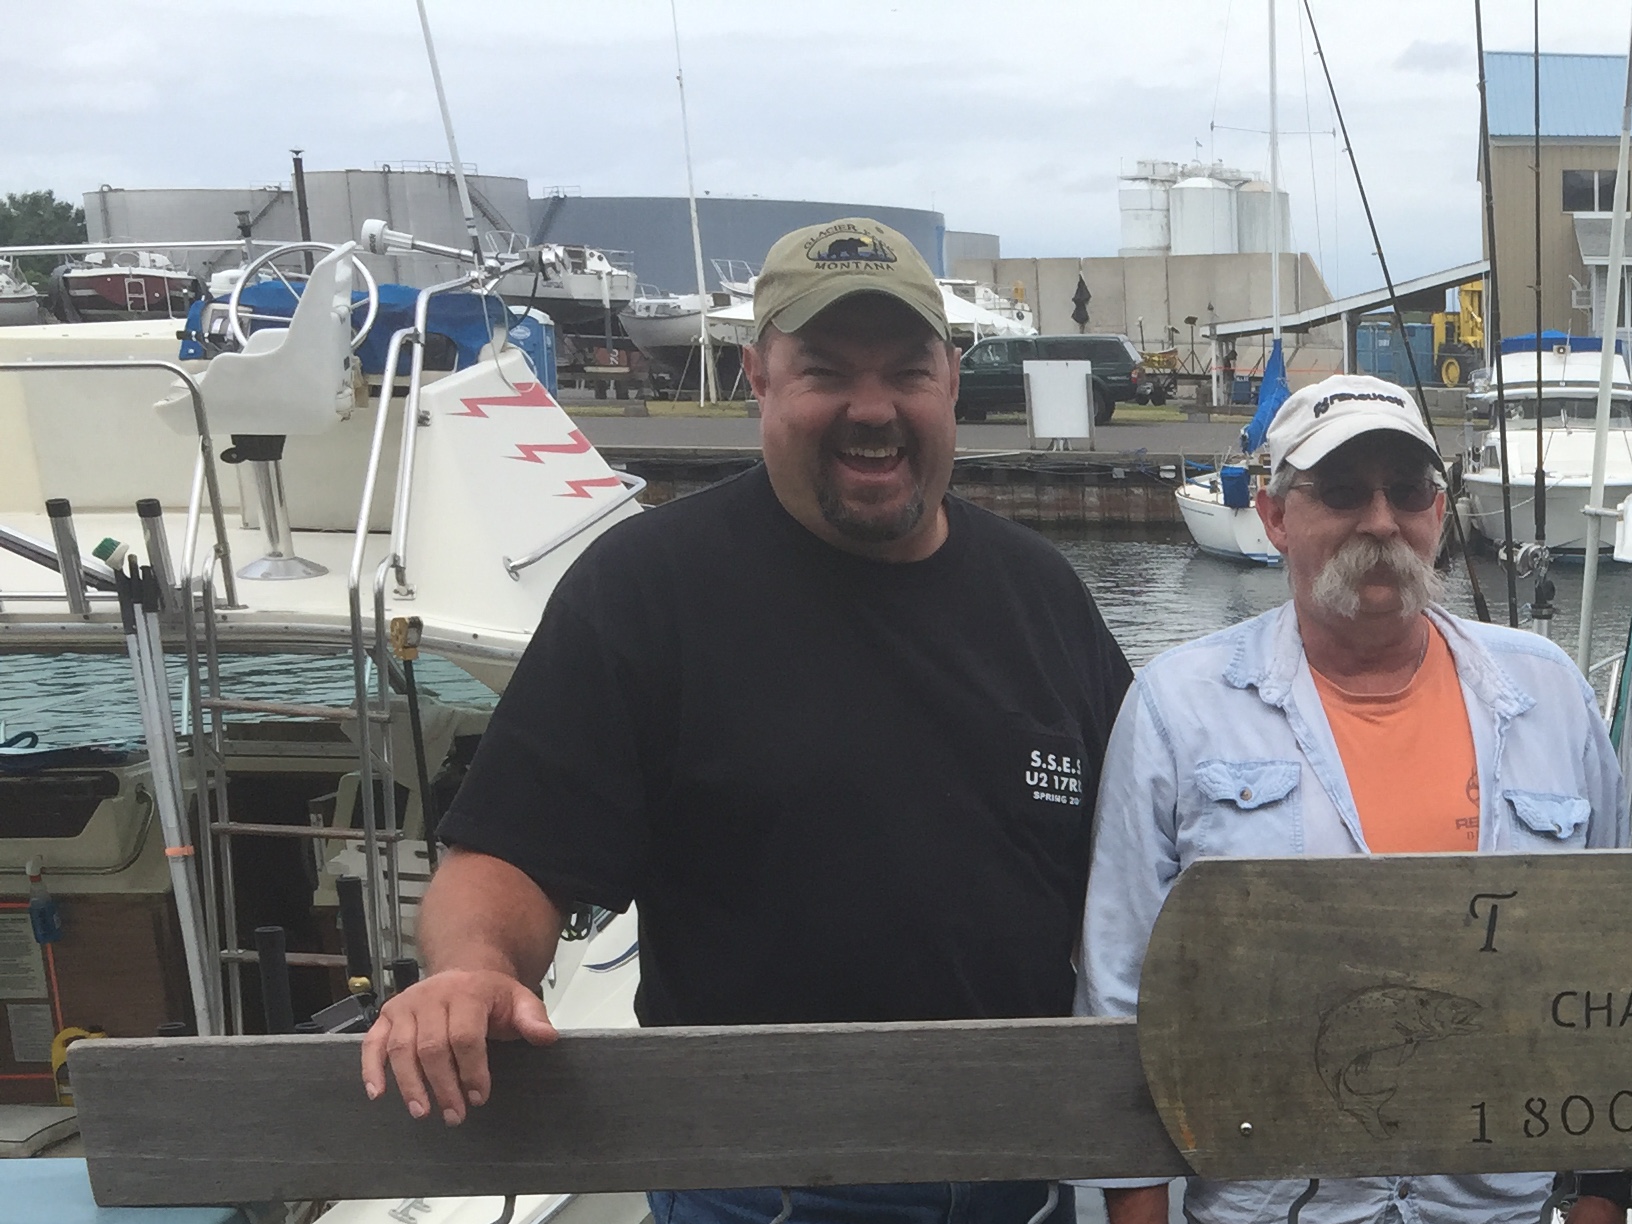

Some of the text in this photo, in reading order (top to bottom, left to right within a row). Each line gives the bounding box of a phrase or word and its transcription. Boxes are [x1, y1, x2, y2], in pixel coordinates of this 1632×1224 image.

[803, 223, 858, 250] GLACIER
[814, 261, 895, 271] MONTANA
[1025, 770, 1049, 788] U2
[1032, 791, 1068, 804] SPRING
[1469, 890, 1519, 953] T
[1471, 1101, 1493, 1144] 1
